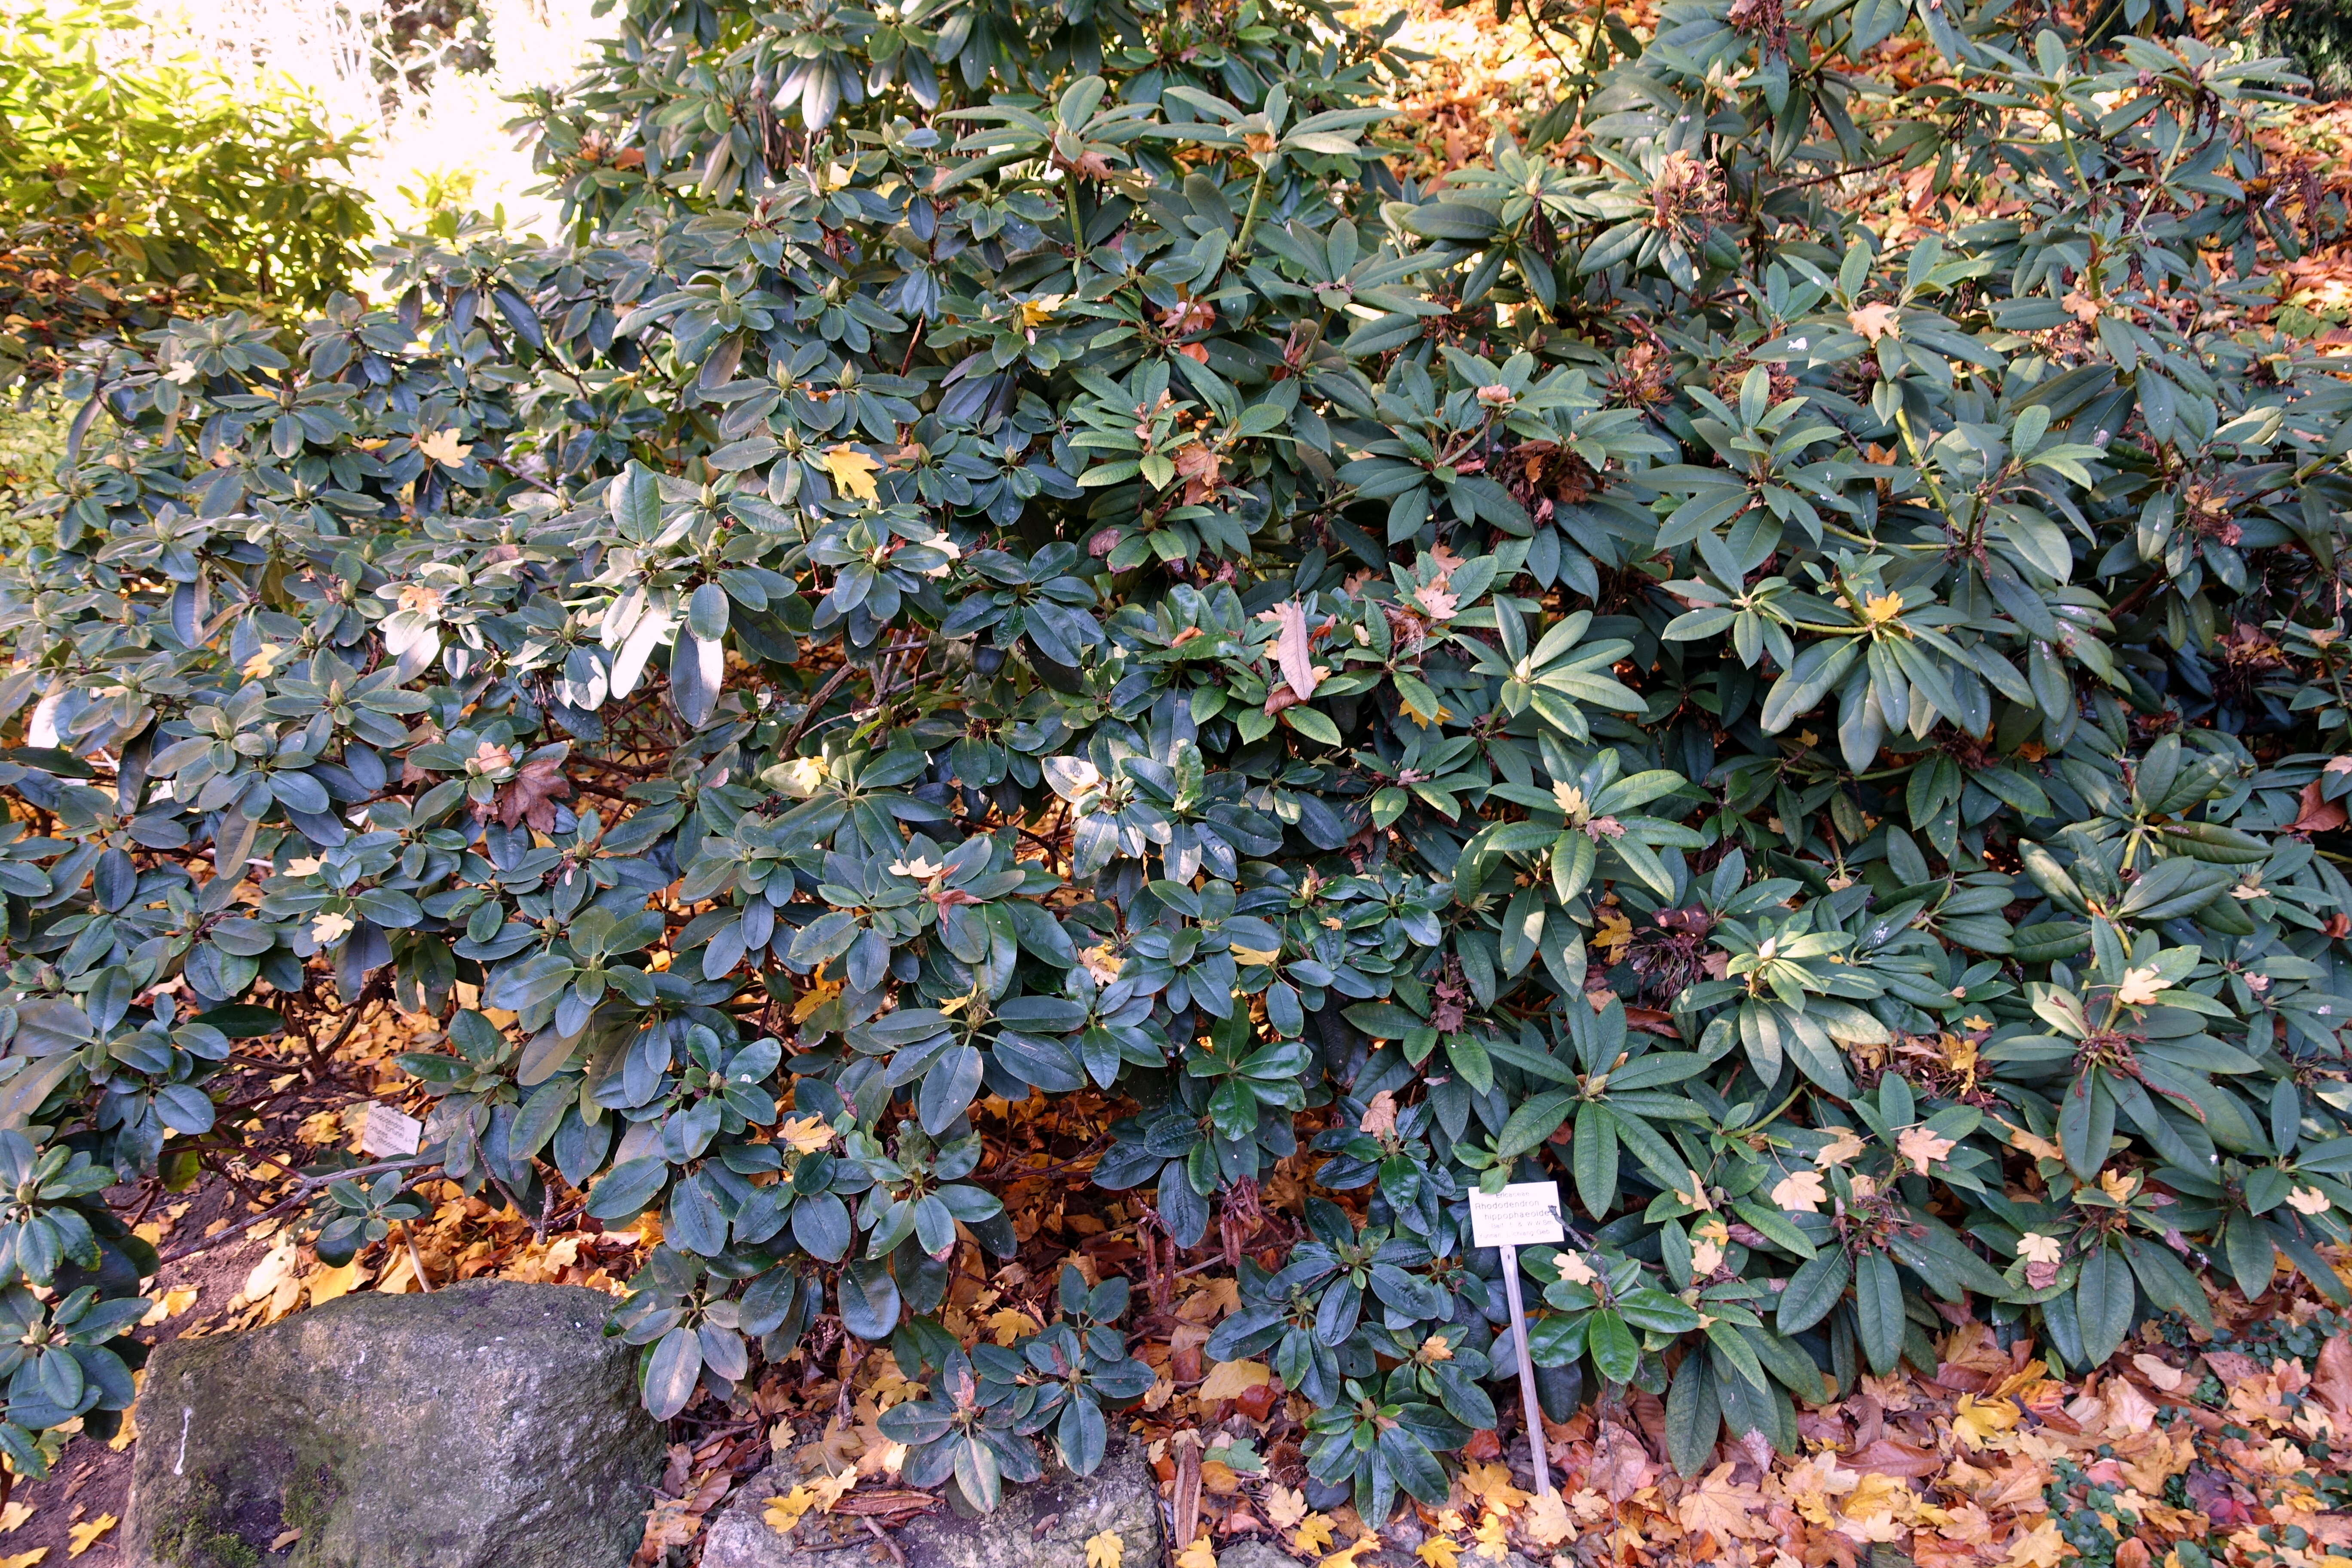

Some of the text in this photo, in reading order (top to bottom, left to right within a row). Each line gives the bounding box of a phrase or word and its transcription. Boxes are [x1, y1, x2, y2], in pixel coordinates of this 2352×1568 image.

[369, 1109, 404, 1132] Rhododendron
[376, 1135, 406, 1152] Rhododend
[1475, 1200, 1539, 1210] Rhododendron
[1485, 1210, 1552, 1221] hippophaeoide
